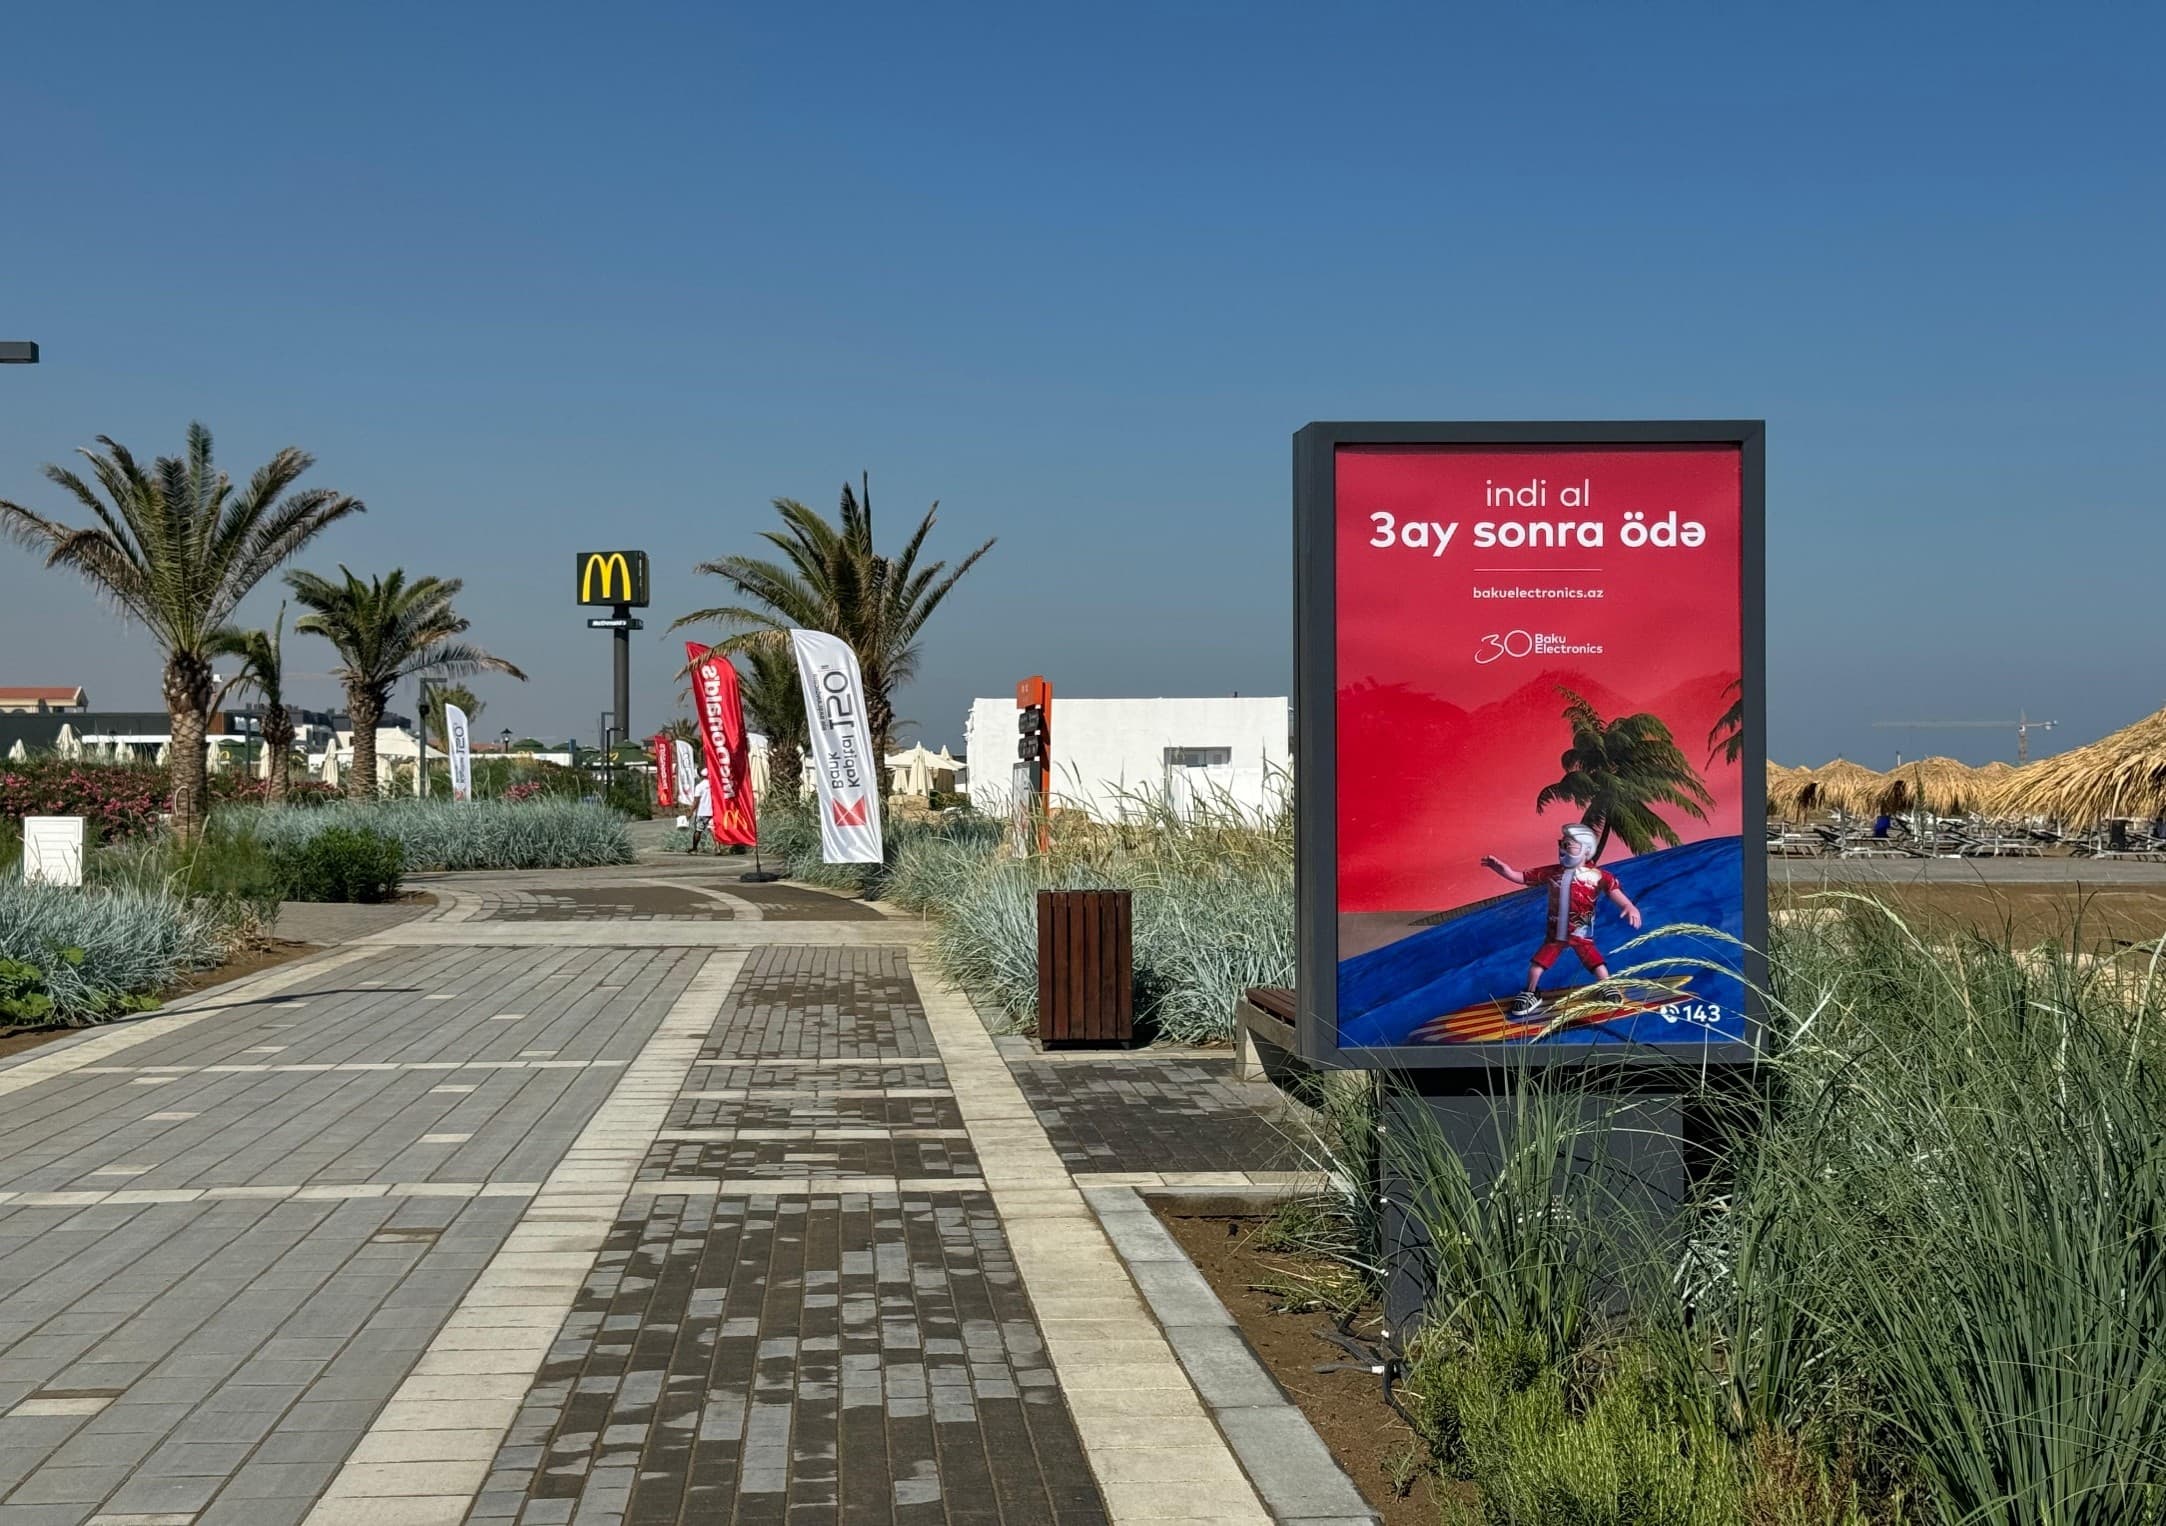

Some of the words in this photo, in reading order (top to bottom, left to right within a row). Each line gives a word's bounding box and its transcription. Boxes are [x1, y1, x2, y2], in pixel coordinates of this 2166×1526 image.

[1485, 478, 1546, 507] indi
[1560, 478, 1590, 507] al
[1369, 511, 1459, 557] 3ay
[1473, 520, 1604, 548] sonra
[1620, 511, 1706, 548] ödə
[1473, 587, 1604, 599] bakuelectronics.az
[1474, 629, 1532, 664] 30
[1535, 633, 1566, 646] Baku
[1535, 643, 1603, 655] Electronics
[1682, 1004, 1721, 1022] 143
